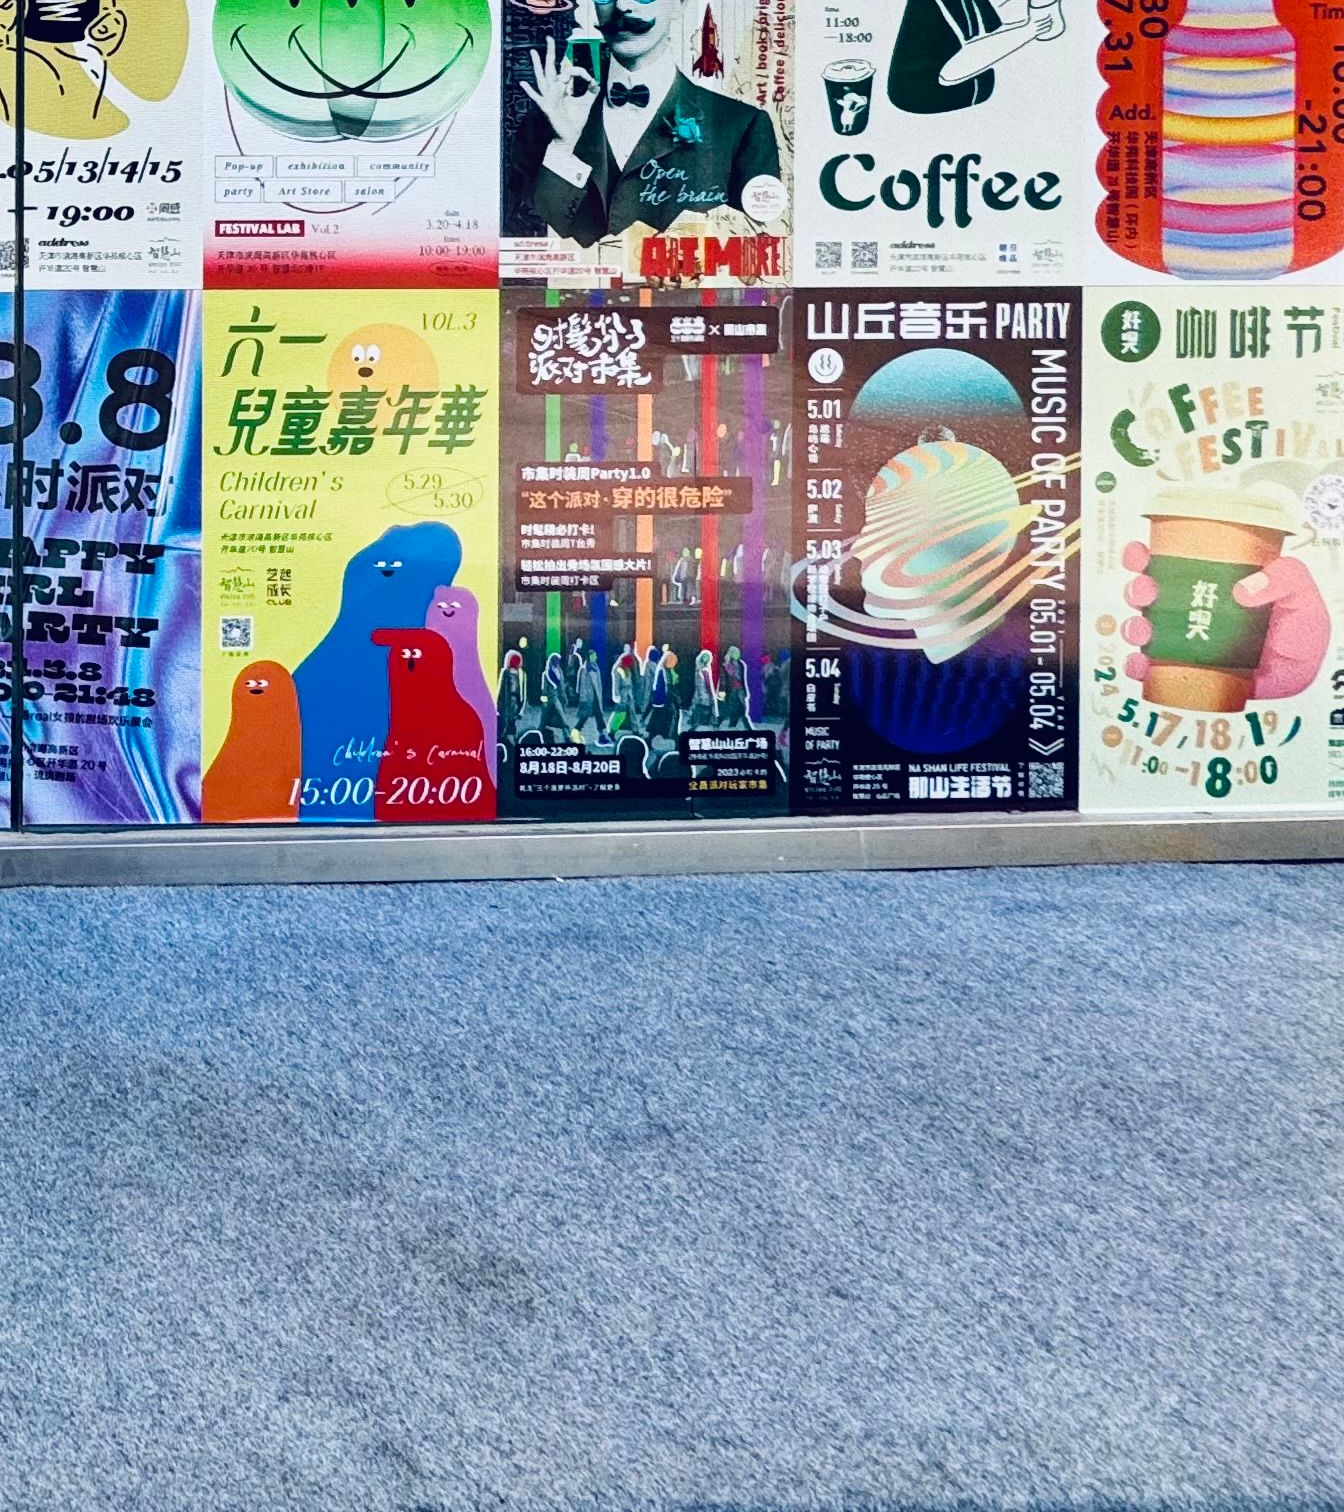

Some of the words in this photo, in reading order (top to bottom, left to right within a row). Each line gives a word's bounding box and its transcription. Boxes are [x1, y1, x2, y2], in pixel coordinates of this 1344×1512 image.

[825, 17, 860, 28] 11:00
[1109, 104, 1156, 121] Add.
[288, 161, 345, 172] exhibition
[641, 159, 688, 182] Open
[677, 188, 728, 205] brain
[819, 153, 1062, 229] Coffee
[47, 206, 135, 225] 19:00
[219, 223, 271, 235] FESTIVAL
[274, 223, 300, 235] LAB
[419, 245, 485, 257] 10:00-19:00
[807, 302, 986, 341] 山丘音乐
[996, 303, 1070, 339] PARTY
[221, 307, 327, 378] 六一
[1031, 349, 1068, 445] MUSIC
[807, 399, 841, 419] 5.01
[214, 384, 488, 456] 兒童嘉年華
[404, 474, 442, 490] 5.29
[521, 466, 650, 482] 市集时装周Party1.0
[807, 480, 842, 499] 5.02
[220, 499, 317, 521] Carnival
[520, 747, 578, 757] 16:00-22:00
[520, 761, 620, 775] 8月18日-8月20日
[289, 777, 482, 807] 15:00-20:00
[909, 776, 1011, 798] 那山生活节
